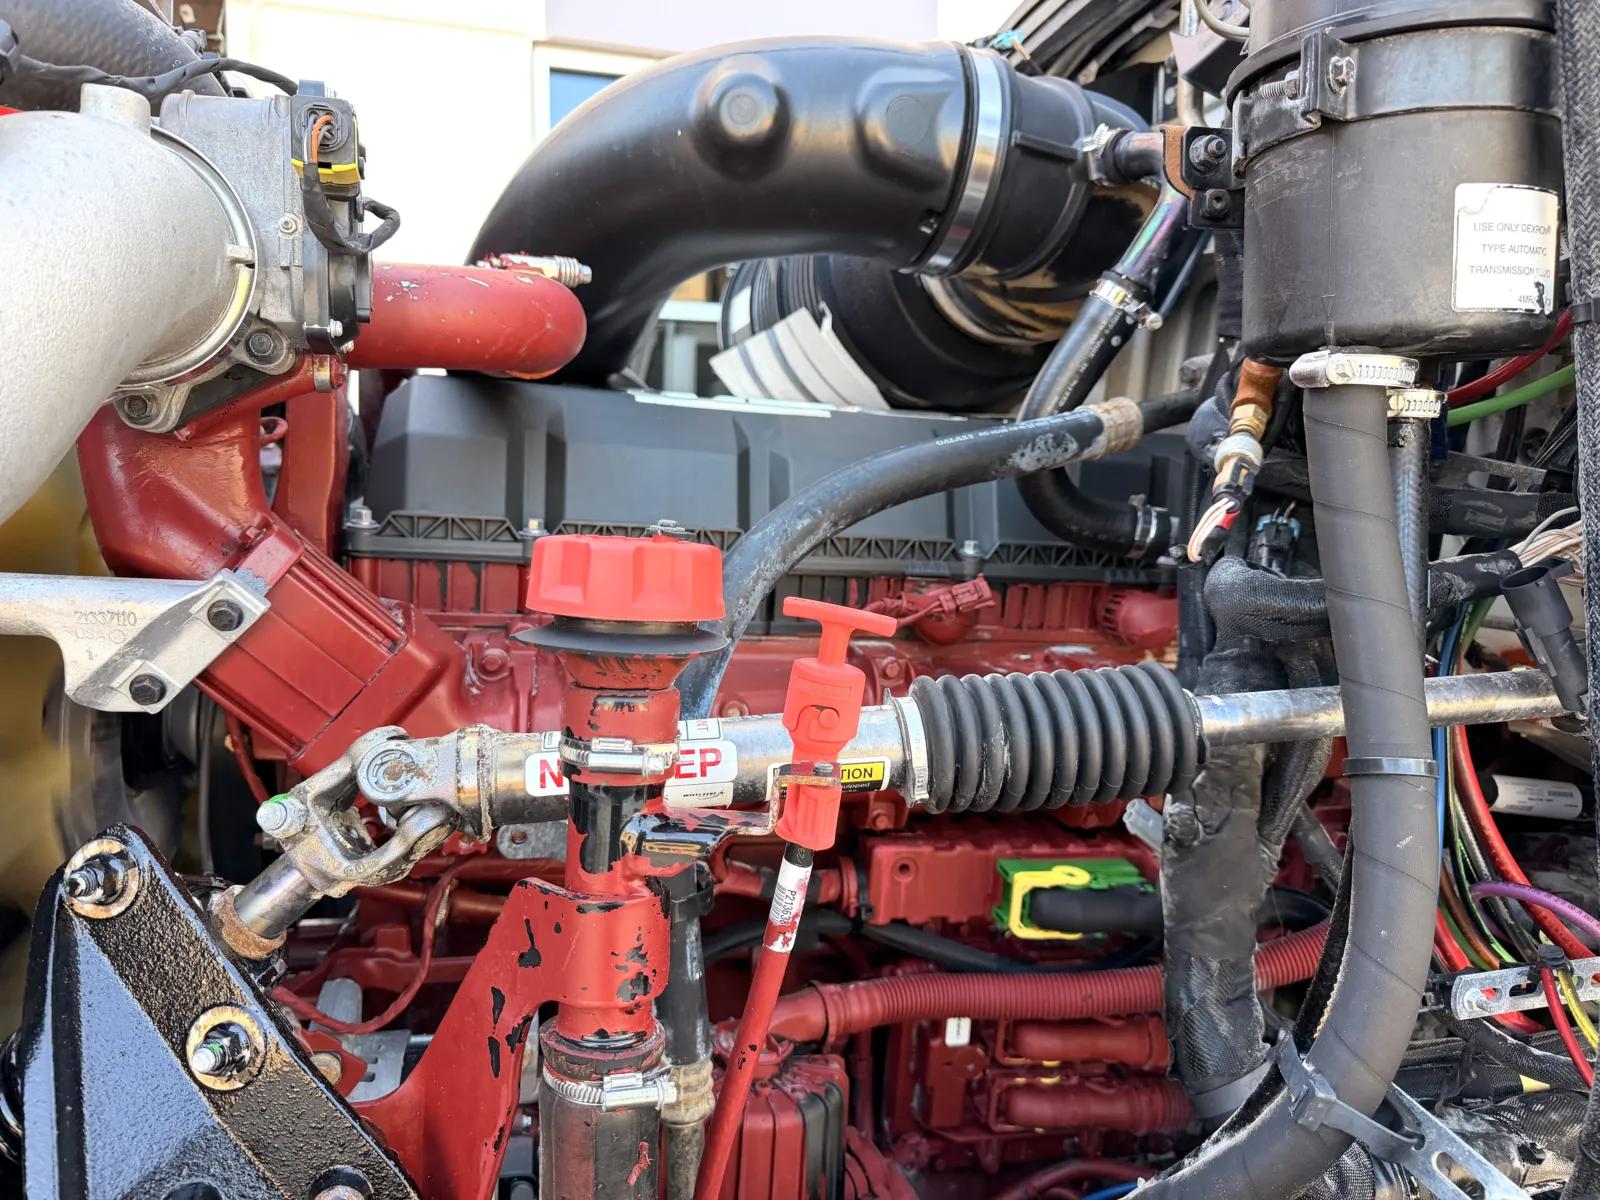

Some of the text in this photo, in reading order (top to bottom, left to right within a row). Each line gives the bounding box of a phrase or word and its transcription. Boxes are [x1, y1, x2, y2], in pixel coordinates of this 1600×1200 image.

[1473, 222, 1495, 232] USE
[1496, 222, 1520, 233] ONLY
[1481, 243, 1506, 254] TYPE
[1468, 264, 1535, 277] TRANSMISSION
[539, 747, 723, 789] N EP
[841, 767, 874, 780] TION
